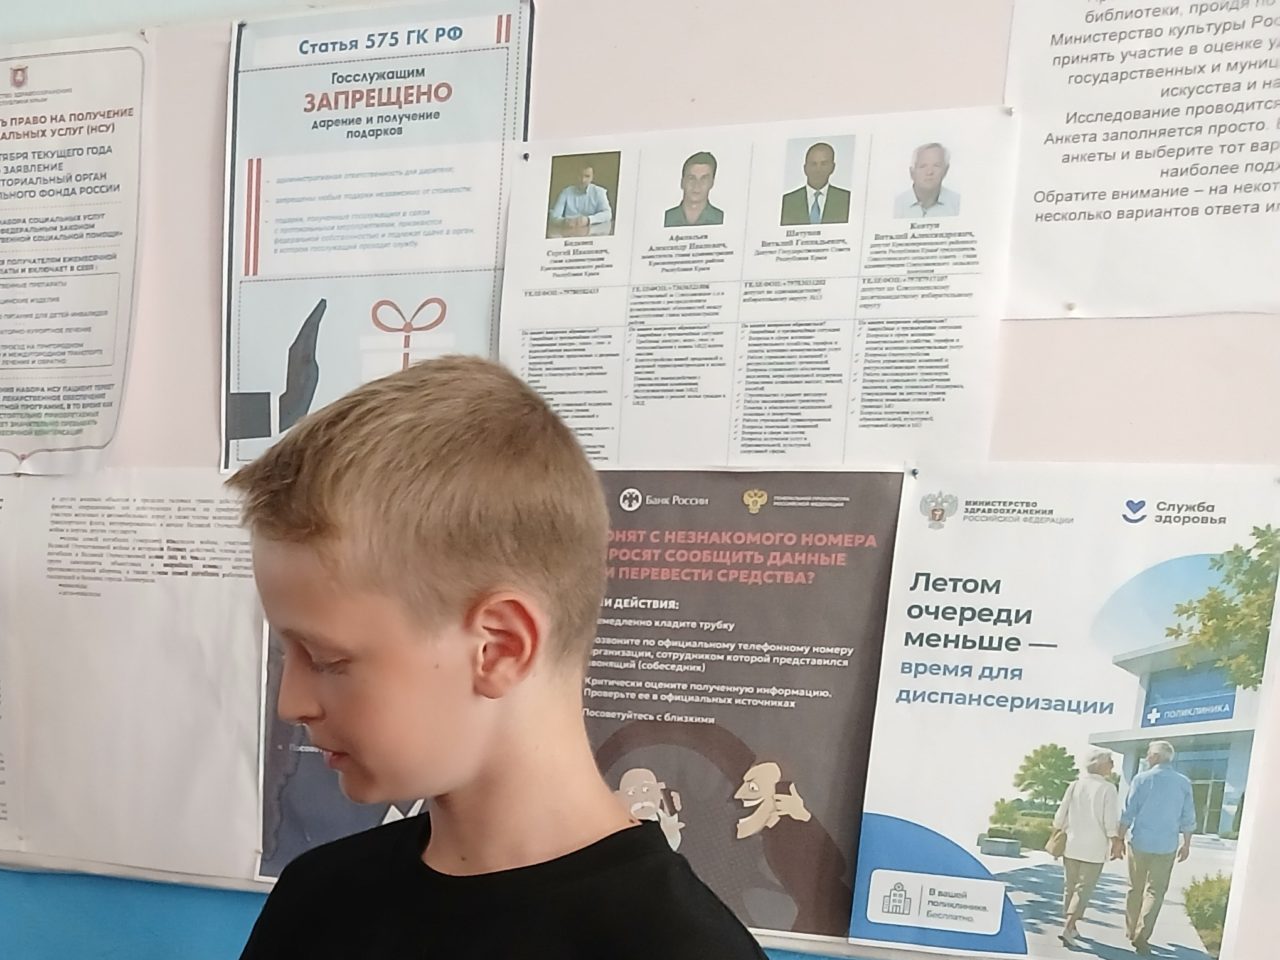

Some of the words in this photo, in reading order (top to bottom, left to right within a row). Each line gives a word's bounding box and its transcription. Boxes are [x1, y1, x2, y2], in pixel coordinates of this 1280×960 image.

[298, 38, 358, 55] Статья
[365, 32, 399, 50] 575
[406, 29, 429, 46] ГК
[435, 25, 463, 43] РФ
[1050, 28, 1164, 47] Министерство
[1168, 20, 1246, 40] культуры
[1052, 52, 1115, 67] принять
[1120, 45, 1184, 64] участие
[1188, 44, 1198, 55] в
[1203, 39, 1263, 55] оценке
[331, 67, 426, 86] Госслужащим
[1068, 63, 1206, 86] государственных
[1211, 63, 1221, 74] и
[303, 82, 453, 113] ЗАПРЕЩЕНО
[1160, 81, 1242, 99] искусства
[1247, 80, 1257, 91] и
[10, 115, 47, 127] ПРАВО
[50, 114, 66, 124] НА
[69, 107, 134, 122] ПОЛУЧЕНИЕ
[311, 115, 362, 130] дарение
[366, 116, 373, 125] и
[376, 110, 441, 126] получение
[1066, 105, 1181, 125] Исследование
[50, 126, 83, 138] УСЛУГ
[86, 122, 115, 135] (НСУ)
[346, 127, 403, 140] подарков
[1043, 132, 1097, 145] Анкета
[1102, 126, 1203, 143] заполняется
[31, 148, 84, 159] ТЕКУЩЕГО
[86, 145, 112, 156] ГОДА
[1061, 150, 1116, 164] анкеты
[1121, 150, 1130, 161] и
[1134, 143, 1214, 160] выберите
[1219, 142, 1246, 154] тот
[3, 162, 64, 175] ЗАЯВЛЕНИЕ
[74, 172, 107, 182] ОРГАН
[1160, 162, 1239, 178] наиболее
[38, 187, 77, 198] ФОНДА
[80, 184, 120, 195] РОССИИ
[1033, 190, 1107, 206] Обратите
[1111, 186, 1189, 201] внимание
[1208, 183, 1228, 195] на
[1035, 208, 1112, 223] несколько
[1116, 205, 1199, 221] вариантов
[1204, 202, 1260, 216] ответа
[645, 495, 669, 505] Банк
[672, 494, 709, 506] России
[964, 500, 1038, 508] МИНИСТЕРСТВО
[1156, 501, 1215, 514] Служба
[964, 508, 1054, 516] ЗДРАВООХРАНЕНИЯ
[1154, 514, 1227, 526] здоровья
[650, 531, 660, 543] С
[664, 532, 796, 546] НЕЗНАКОМОГО
[802, 534, 878, 548] НОМЕРА
[664, 549, 764, 565] СООБЩИТЬ
[766, 552, 847, 567] ДАННЫЕ
[618, 567, 713, 581] ПЕРЕВЕСТИ
[716, 569, 816, 585] СРЕДСТВА?
[910, 572, 1002, 596] Летом
[614, 596, 680, 610] ДЕЙСТВИЯ:
[906, 604, 1033, 627] очереди
[654, 620, 696, 628] кладите
[700, 620, 735, 632] трубку
[642, 638, 656, 646] по
[657, 638, 736, 652] официальному
[738, 642, 810, 654] телефонному
[812, 646, 854, 656] номеру
[904, 630, 1021, 652] меньше
[638, 660, 706, 672] (собеседник)
[656, 650, 724, 662] сотрудником
[726, 654, 771, 665] которой
[772, 656, 849, 666] представился
[900, 660, 974, 680] время
[978, 664, 1024, 682] для
[584, 676, 643, 688] Критически
[644, 682, 688, 690] оцените
[690, 684, 754, 694] полученную
[756, 686, 832, 698] информацию.
[584, 688, 636, 700] Проверьте
[638, 692, 650, 700] ее
[660, 692, 732, 704] официальных
[734, 698, 796, 708] источниках
[896, 687, 1115, 716] диспансеризации
[582, 708, 654, 721] Посоветуйтесь
[664, 712, 716, 724] близкими
